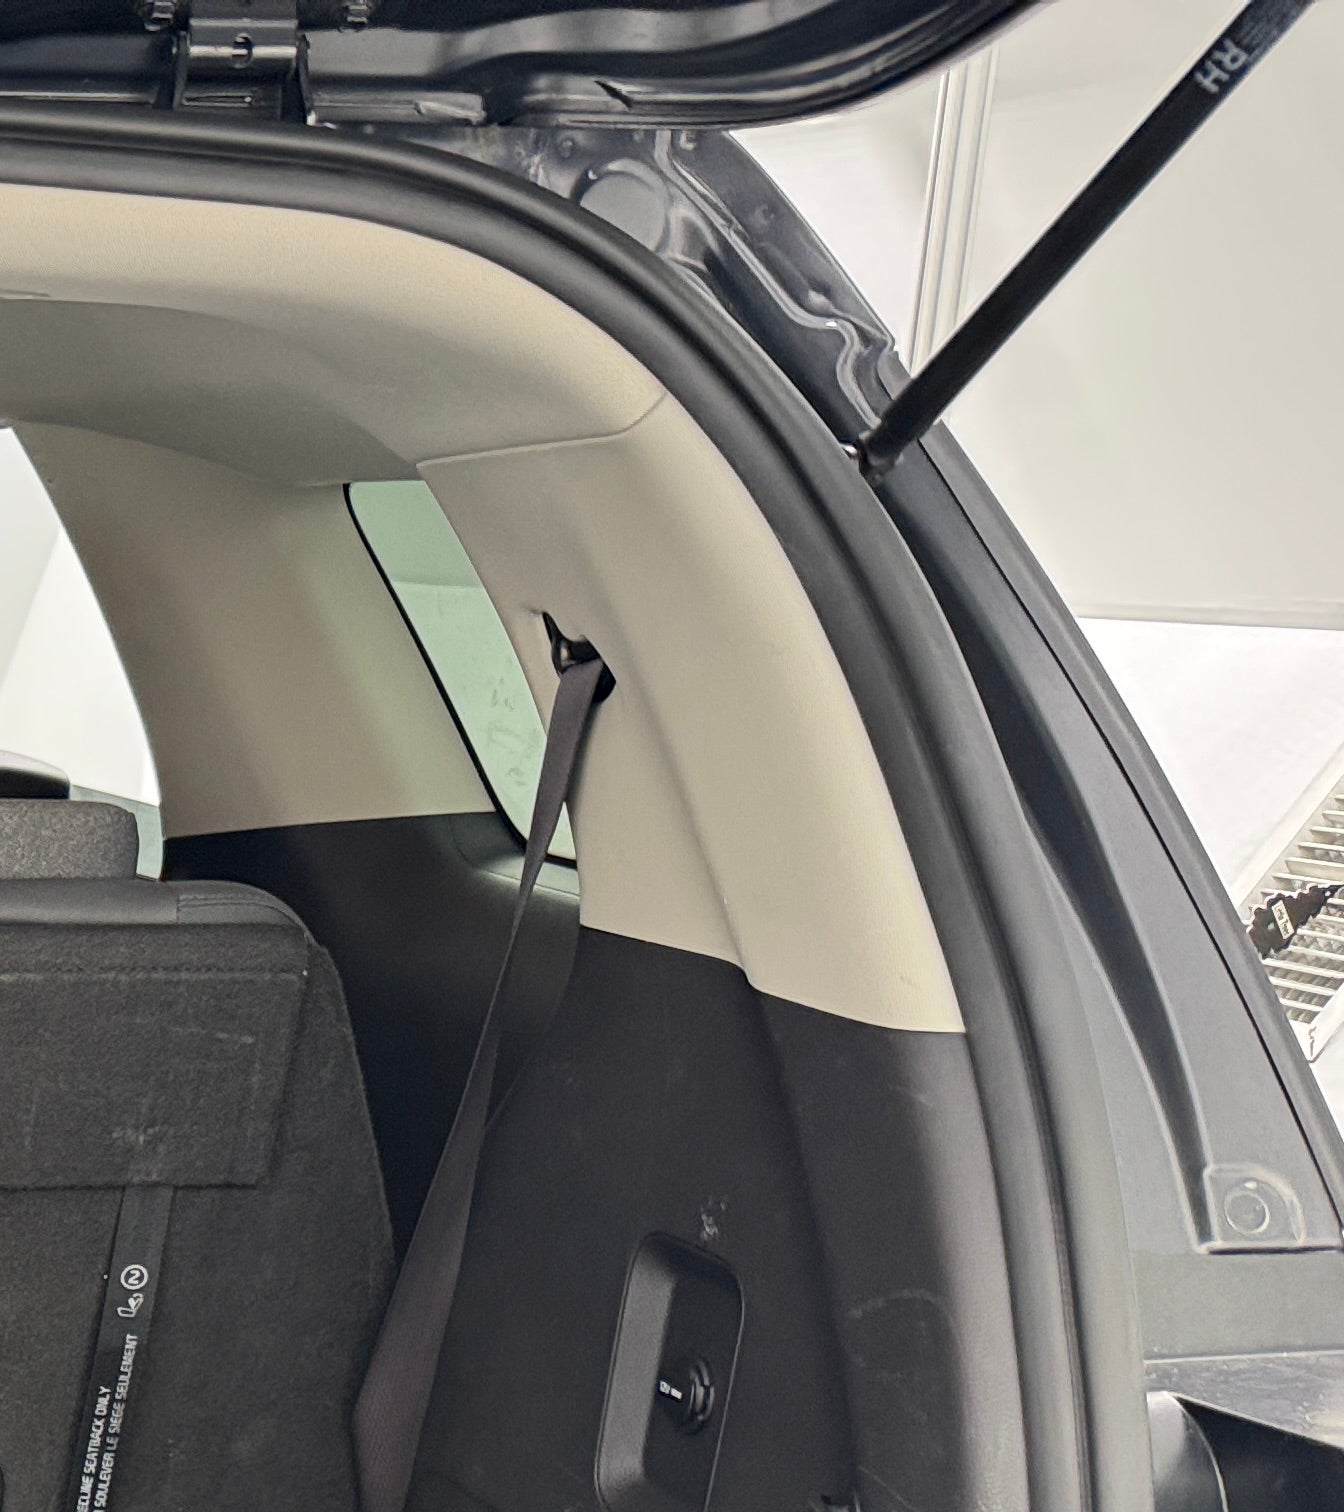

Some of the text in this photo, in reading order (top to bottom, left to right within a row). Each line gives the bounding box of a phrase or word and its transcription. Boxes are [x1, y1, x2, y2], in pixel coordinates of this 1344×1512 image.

[1193, 38, 1249, 94] RH
[94, 1385, 112, 1416] ONLY
[94, 1452, 116, 1507] SOULEVER
[106, 1436, 119, 1450] LE
[115, 1333, 138, 1400] SEULEMENT
[84, 1417, 105, 1474] SEATBACK
